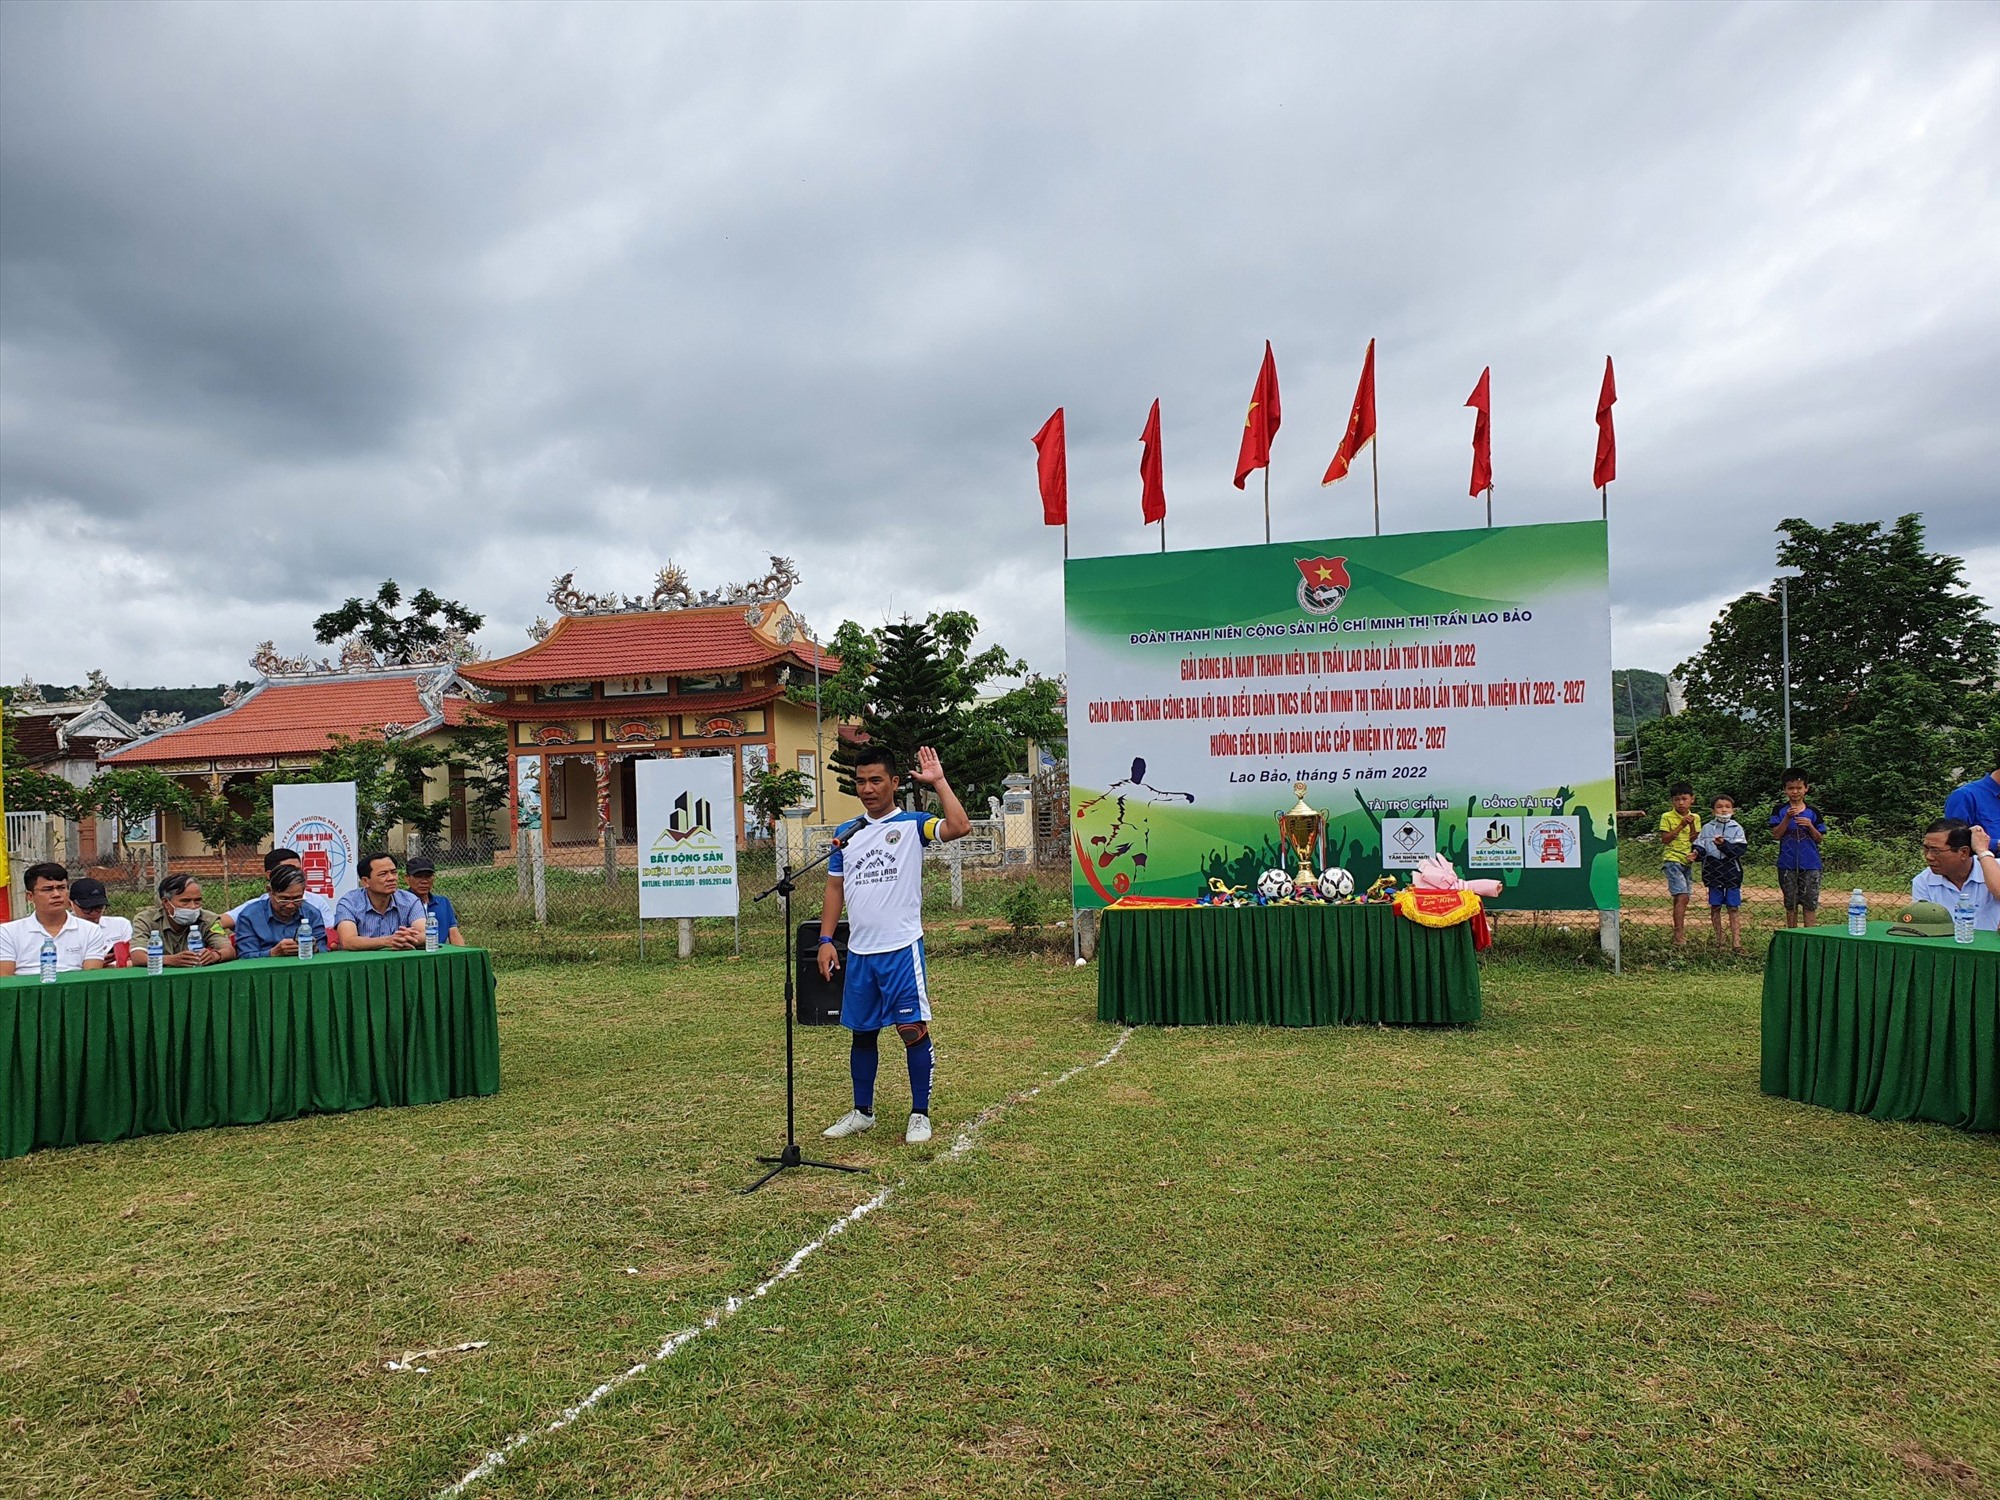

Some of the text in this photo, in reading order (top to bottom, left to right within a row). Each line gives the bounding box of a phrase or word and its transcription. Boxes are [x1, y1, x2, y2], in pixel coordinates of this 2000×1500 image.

[1130, 608, 1532, 645] ĐOÀN THANH NIÊN CỘNG SẢN HỒ CHÍ MINH THỊ TRẤN LAO BẢO
[1181, 640, 1476, 681] GIẢI BÓNG ĐÁ NAM THANH NIÊN THỊ TRẤN LAO BẢO LẦN THỨ VI NĂM 2022
[1089, 697, 1109, 723] CHÀO
[1111, 696, 1134, 722] MỪNG
[1136, 695, 1161, 721] THÀNH
[1163, 694, 1184, 720] CÔNG
[1186, 697, 1199, 722] ĐẠI
[1202, 692, 1215, 722] HỘI
[1216, 695, 1230, 721] ĐẠI
[1232, 686, 1251, 717] BIỂU
[1253, 689, 1275, 716] ĐOÀN
[1277, 692, 1299, 715] TNCS
[1301, 684, 1312, 714] HỒ
[1314, 686, 1328, 713] CHÍ
[1331, 690, 1353, 712] MINH
[1355, 689, 1368, 716] THỊ
[1370, 680, 1393, 710] TRẤN
[1395, 687, 1411, 710] LAO
[1413, 678, 1431, 709] BẢO
[1433, 678, 1450, 708] LẦN
[1452, 680, 1469, 708] THỨ
[1471, 684, 1486, 709] XII,
[1488, 678, 1517, 711] NHIỆM
[1519, 677, 1531, 705] KỲ
[1533, 681, 1555, 705] 2022
[1563, 680, 1585, 704] 2027
[1210, 730, 1238, 756] HƯỚNG
[1240, 726, 1256, 755] ĐẾN
[1258, 732, 1272, 760] ĐẠI
[1274, 727, 1287, 759] HỘI
[1290, 726, 1312, 754] ĐOÀN
[1314, 726, 1332, 752] CÁC
[1334, 722, 1351, 752] CẤP
[1353, 724, 1381, 756] NHIỆM
[1383, 723, 1394, 750] KỲ
[1396, 727, 1417, 750] 2022
[1425, 726, 1446, 749] 2027
[1229, 766, 1428, 784] Lao Bảo, tháng 5 năm 2022
[1368, 797, 1449, 813] TÀI TRỢ CHÍNH
[1482, 794, 1563, 809] ĐỒNG TÀI TRỢ
[296, 833, 313, 841] MINH
[650, 851, 724, 864] BẤT ĐỘNG SẢN
[698, 864, 732, 875] LAND
[880, 867, 898, 876] LAND
